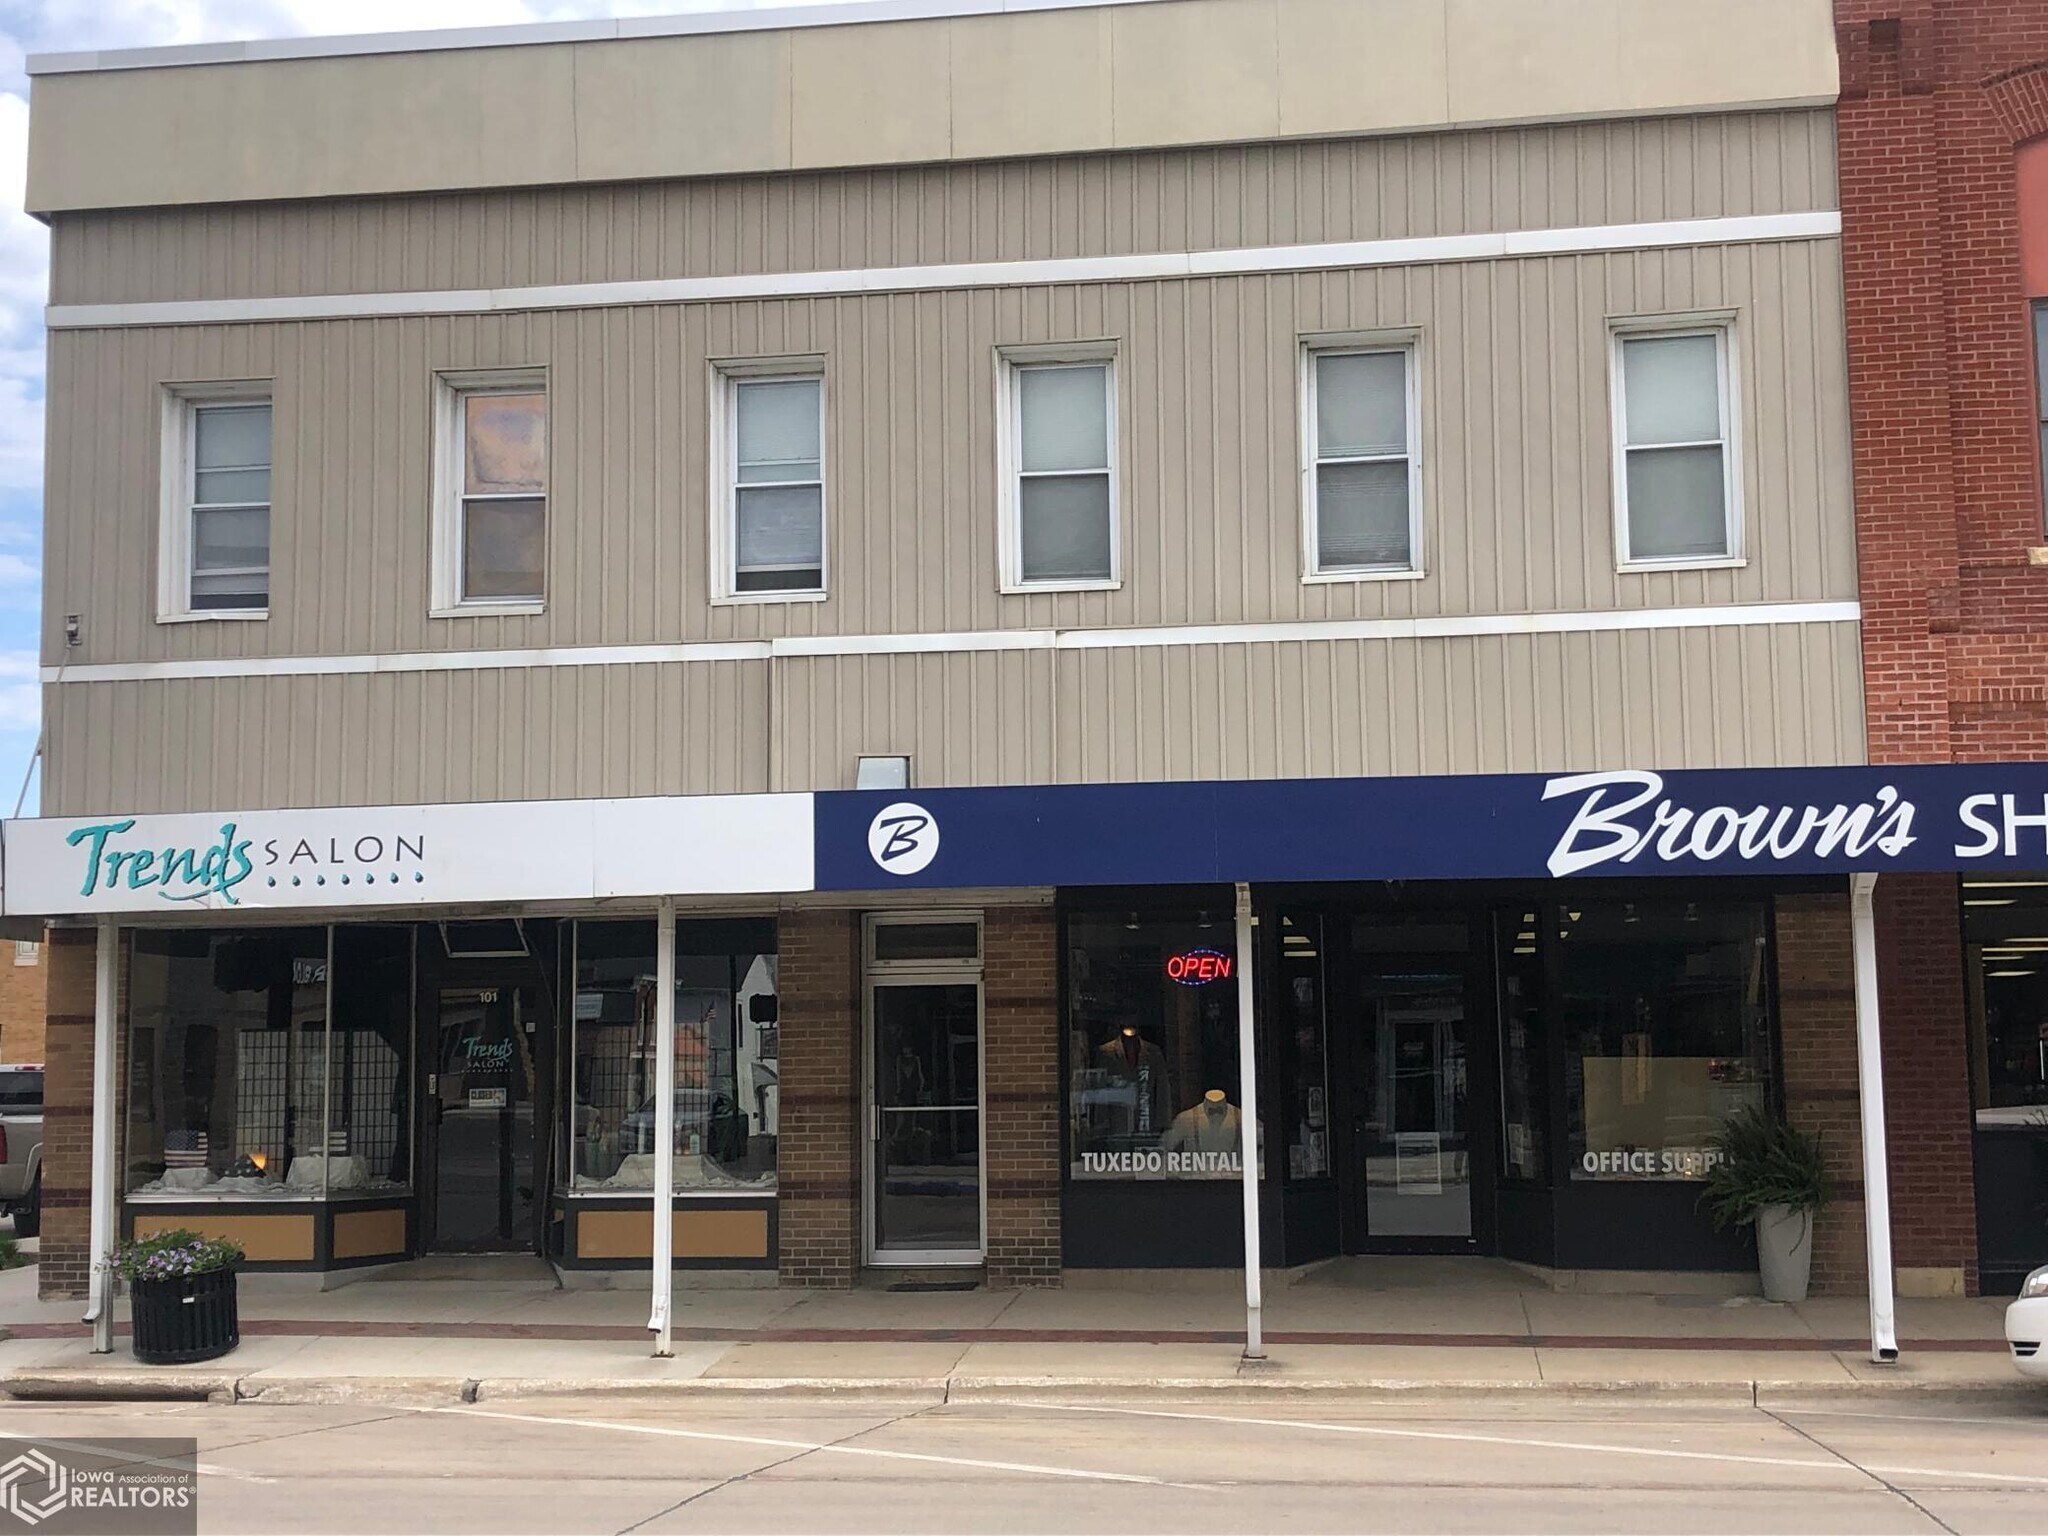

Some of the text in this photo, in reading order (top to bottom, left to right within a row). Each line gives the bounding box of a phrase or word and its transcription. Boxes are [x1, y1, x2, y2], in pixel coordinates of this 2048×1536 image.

[1541, 770, 1917, 878] Brown's
[879, 815, 928, 861] B
[66, 819, 424, 905] Trends SALON
[1167, 956, 1231, 978] OPEN
[480, 992, 497, 1003] 101
[462, 1036, 513, 1062] Trends
[467, 1060, 504, 1068] SALON
[1081, 1152, 1161, 1173] TUXEDO
[1583, 1151, 1655, 1173] OFFICE
